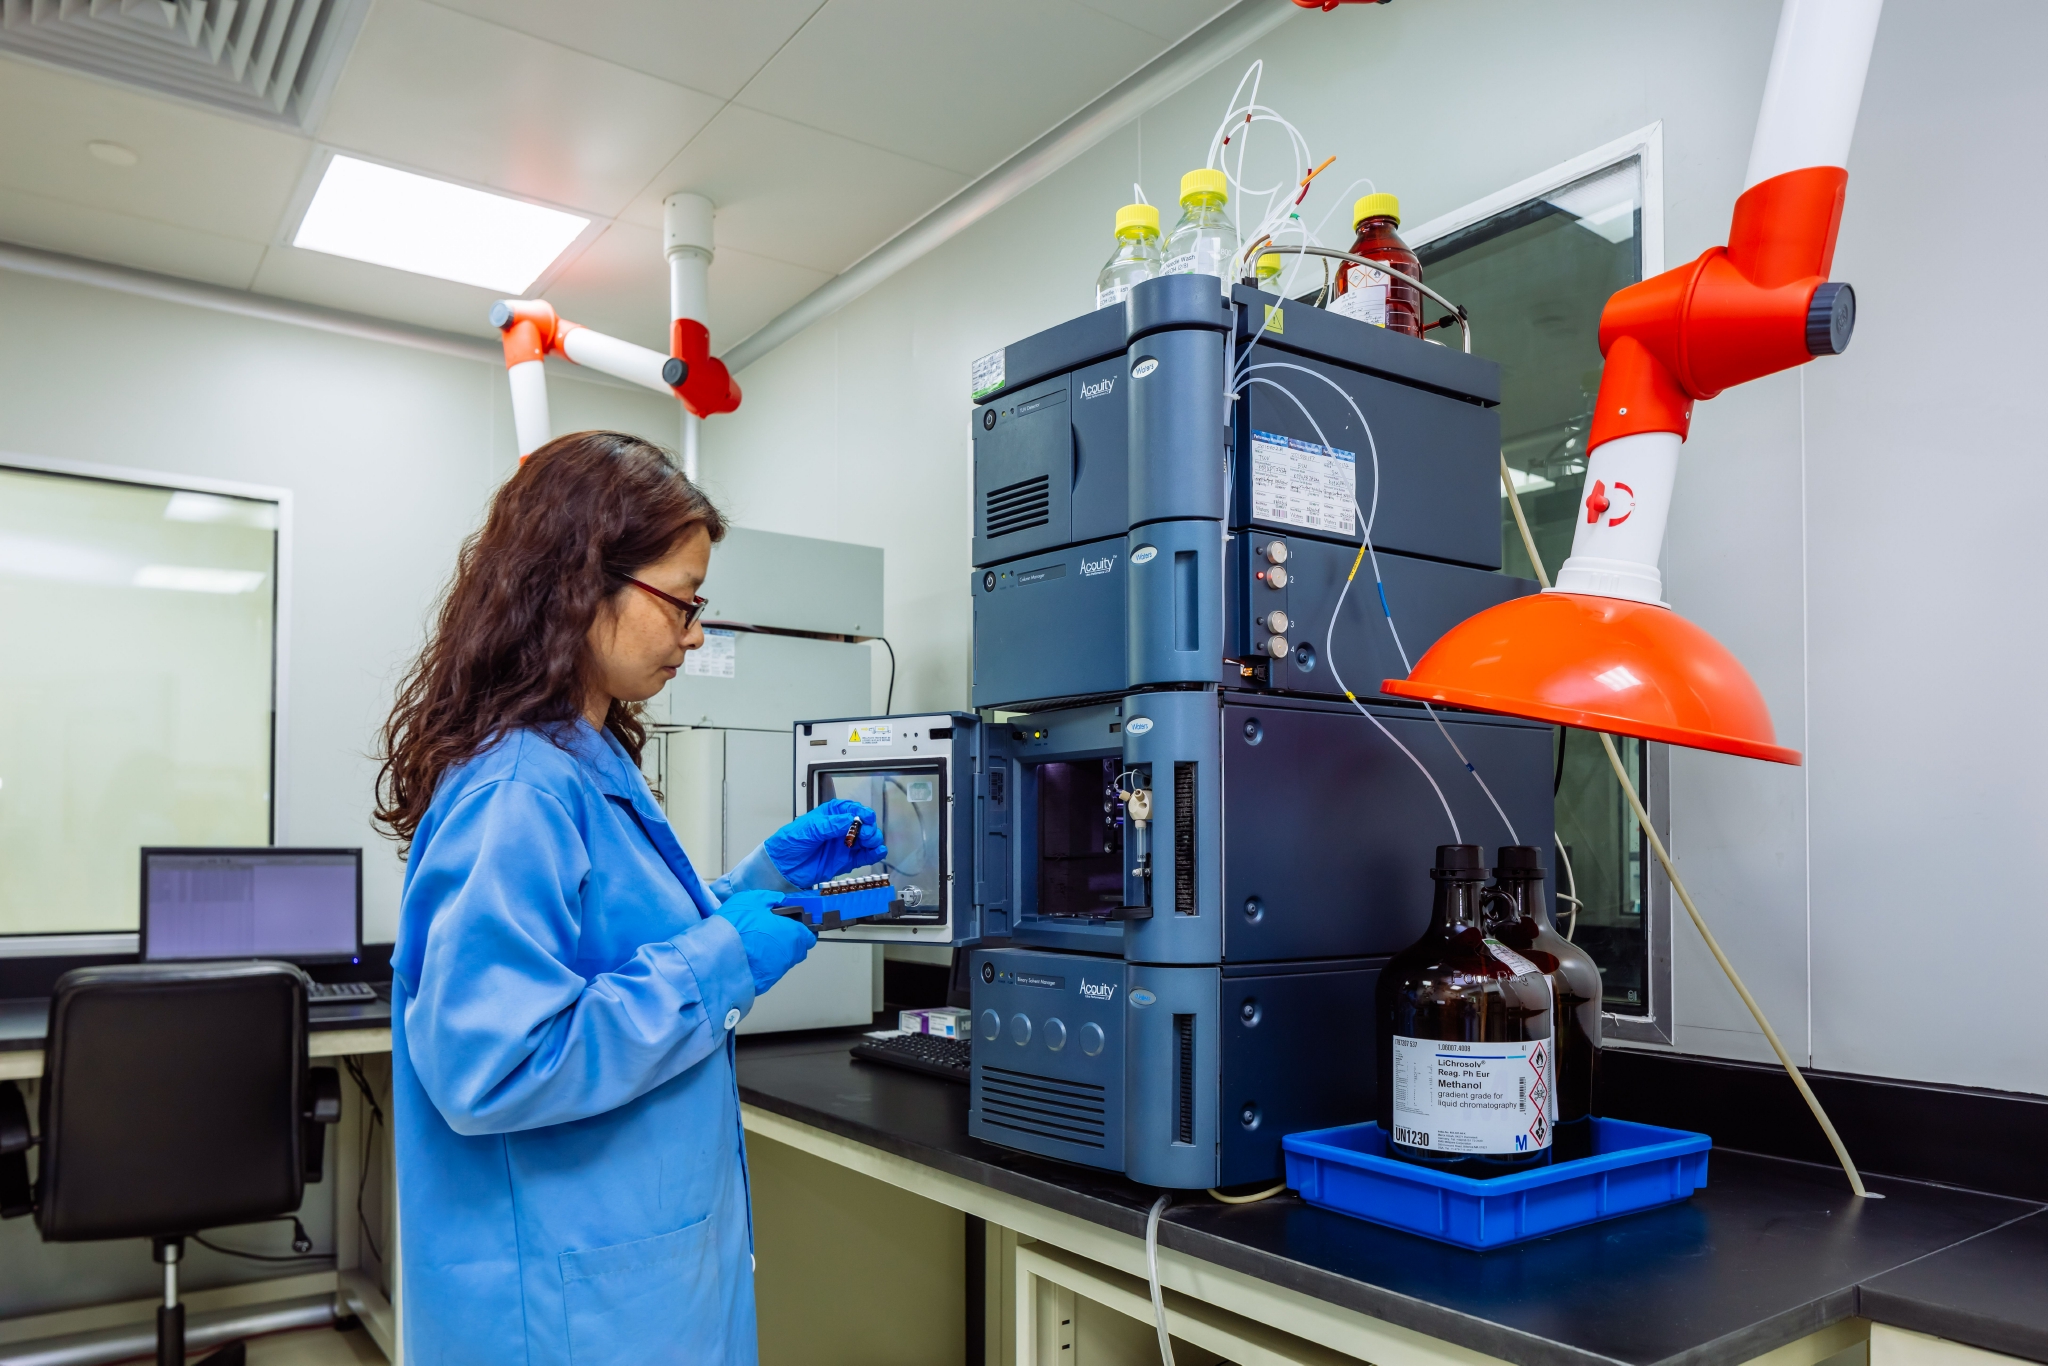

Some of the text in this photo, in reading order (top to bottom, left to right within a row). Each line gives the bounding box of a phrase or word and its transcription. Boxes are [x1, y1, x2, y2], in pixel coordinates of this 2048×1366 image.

[1181, 254, 1196, 263] Wash
[1136, 363, 1154, 376] Waters
[1136, 552, 1153, 561] Waters
[1131, 722, 1149, 731] Waters
[1437, 1068, 1461, 1078] Reag.
[1475, 1070, 1490, 1078] Eur
[1437, 1079, 1482, 1089] Methanol
[1437, 1091, 1469, 1099] gradient
[1470, 1092, 1492, 1100] grade
[1437, 1099, 1518, 1110] liquid chromatography
[1395, 1126, 1430, 1147] UN1230
[1515, 1134, 1528, 1151] M
